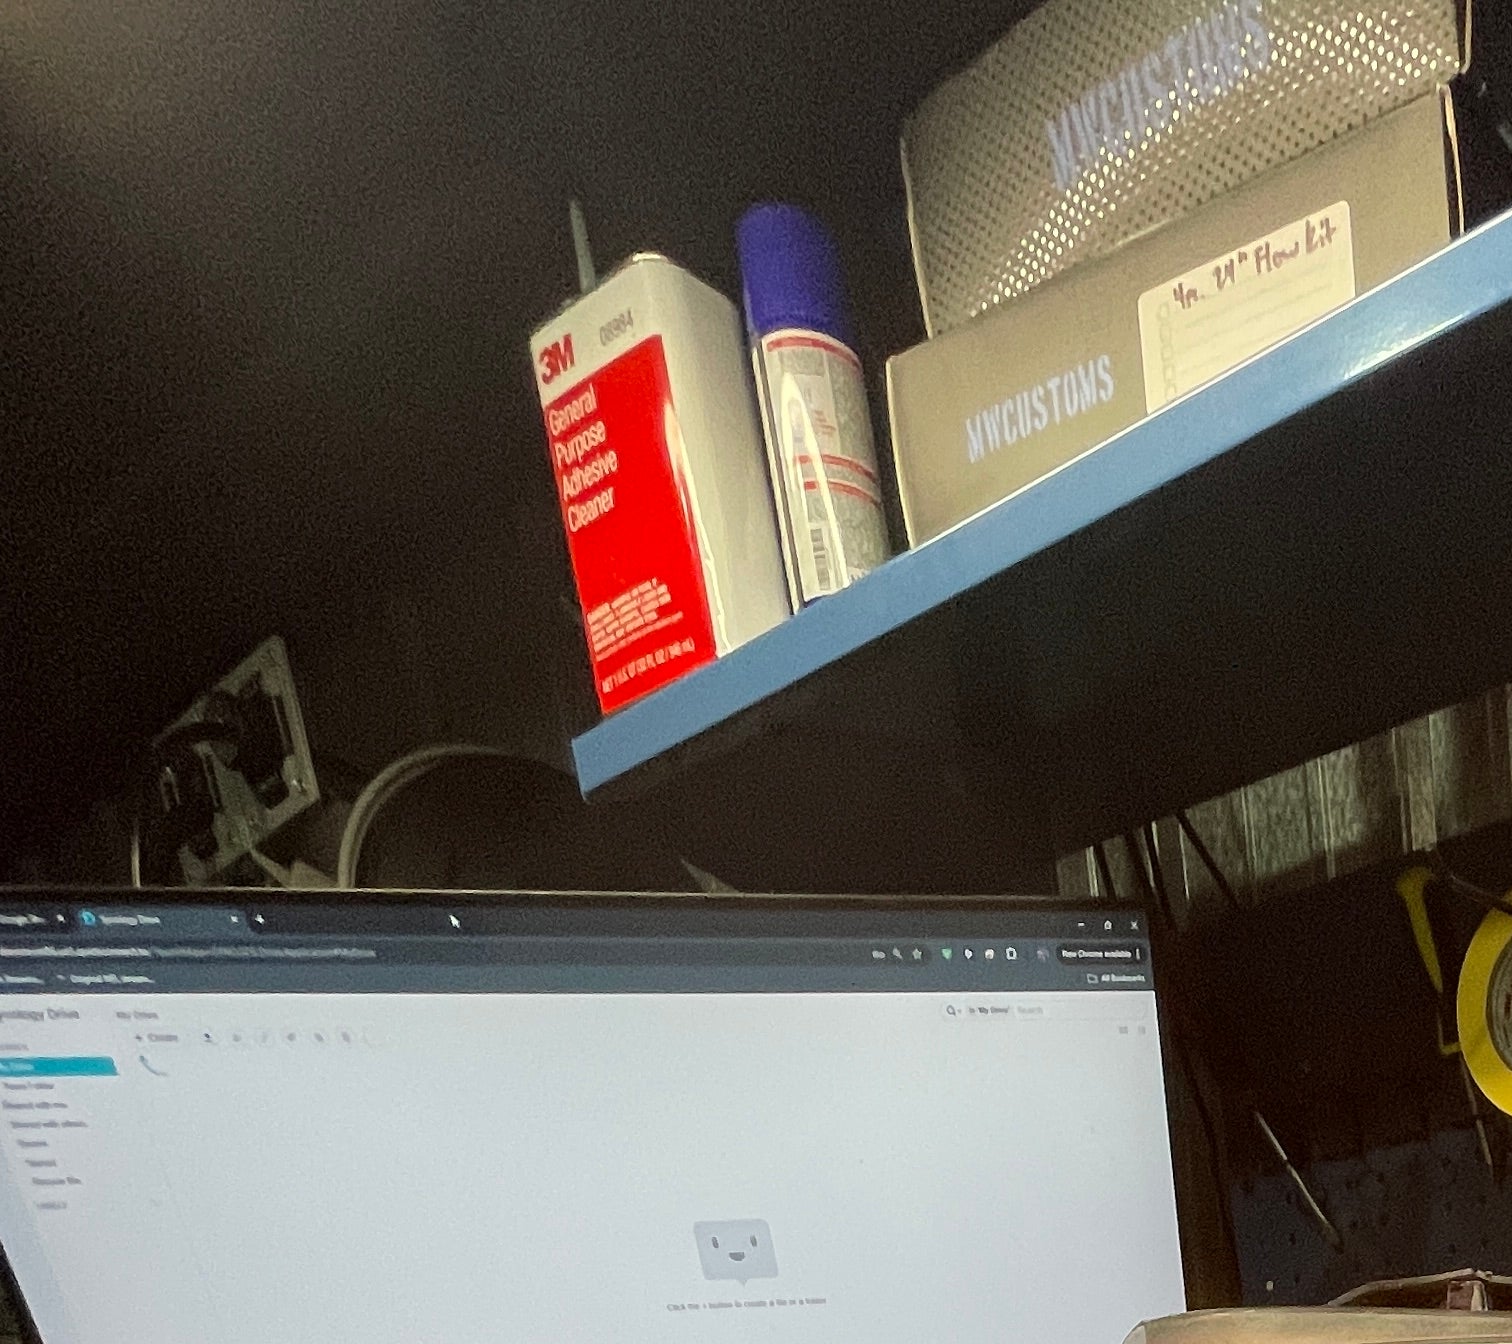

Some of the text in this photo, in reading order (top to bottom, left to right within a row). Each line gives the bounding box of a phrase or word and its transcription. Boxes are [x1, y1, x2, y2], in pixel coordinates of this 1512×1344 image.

[539, 332, 575, 385] 3M
[549, 382, 598, 437] General
[966, 354, 1115, 464] MWCUSTOMS
[554, 420, 607, 469] Purpose
[562, 450, 619, 501] Adhesive
[567, 486, 616, 533] Cleaner
